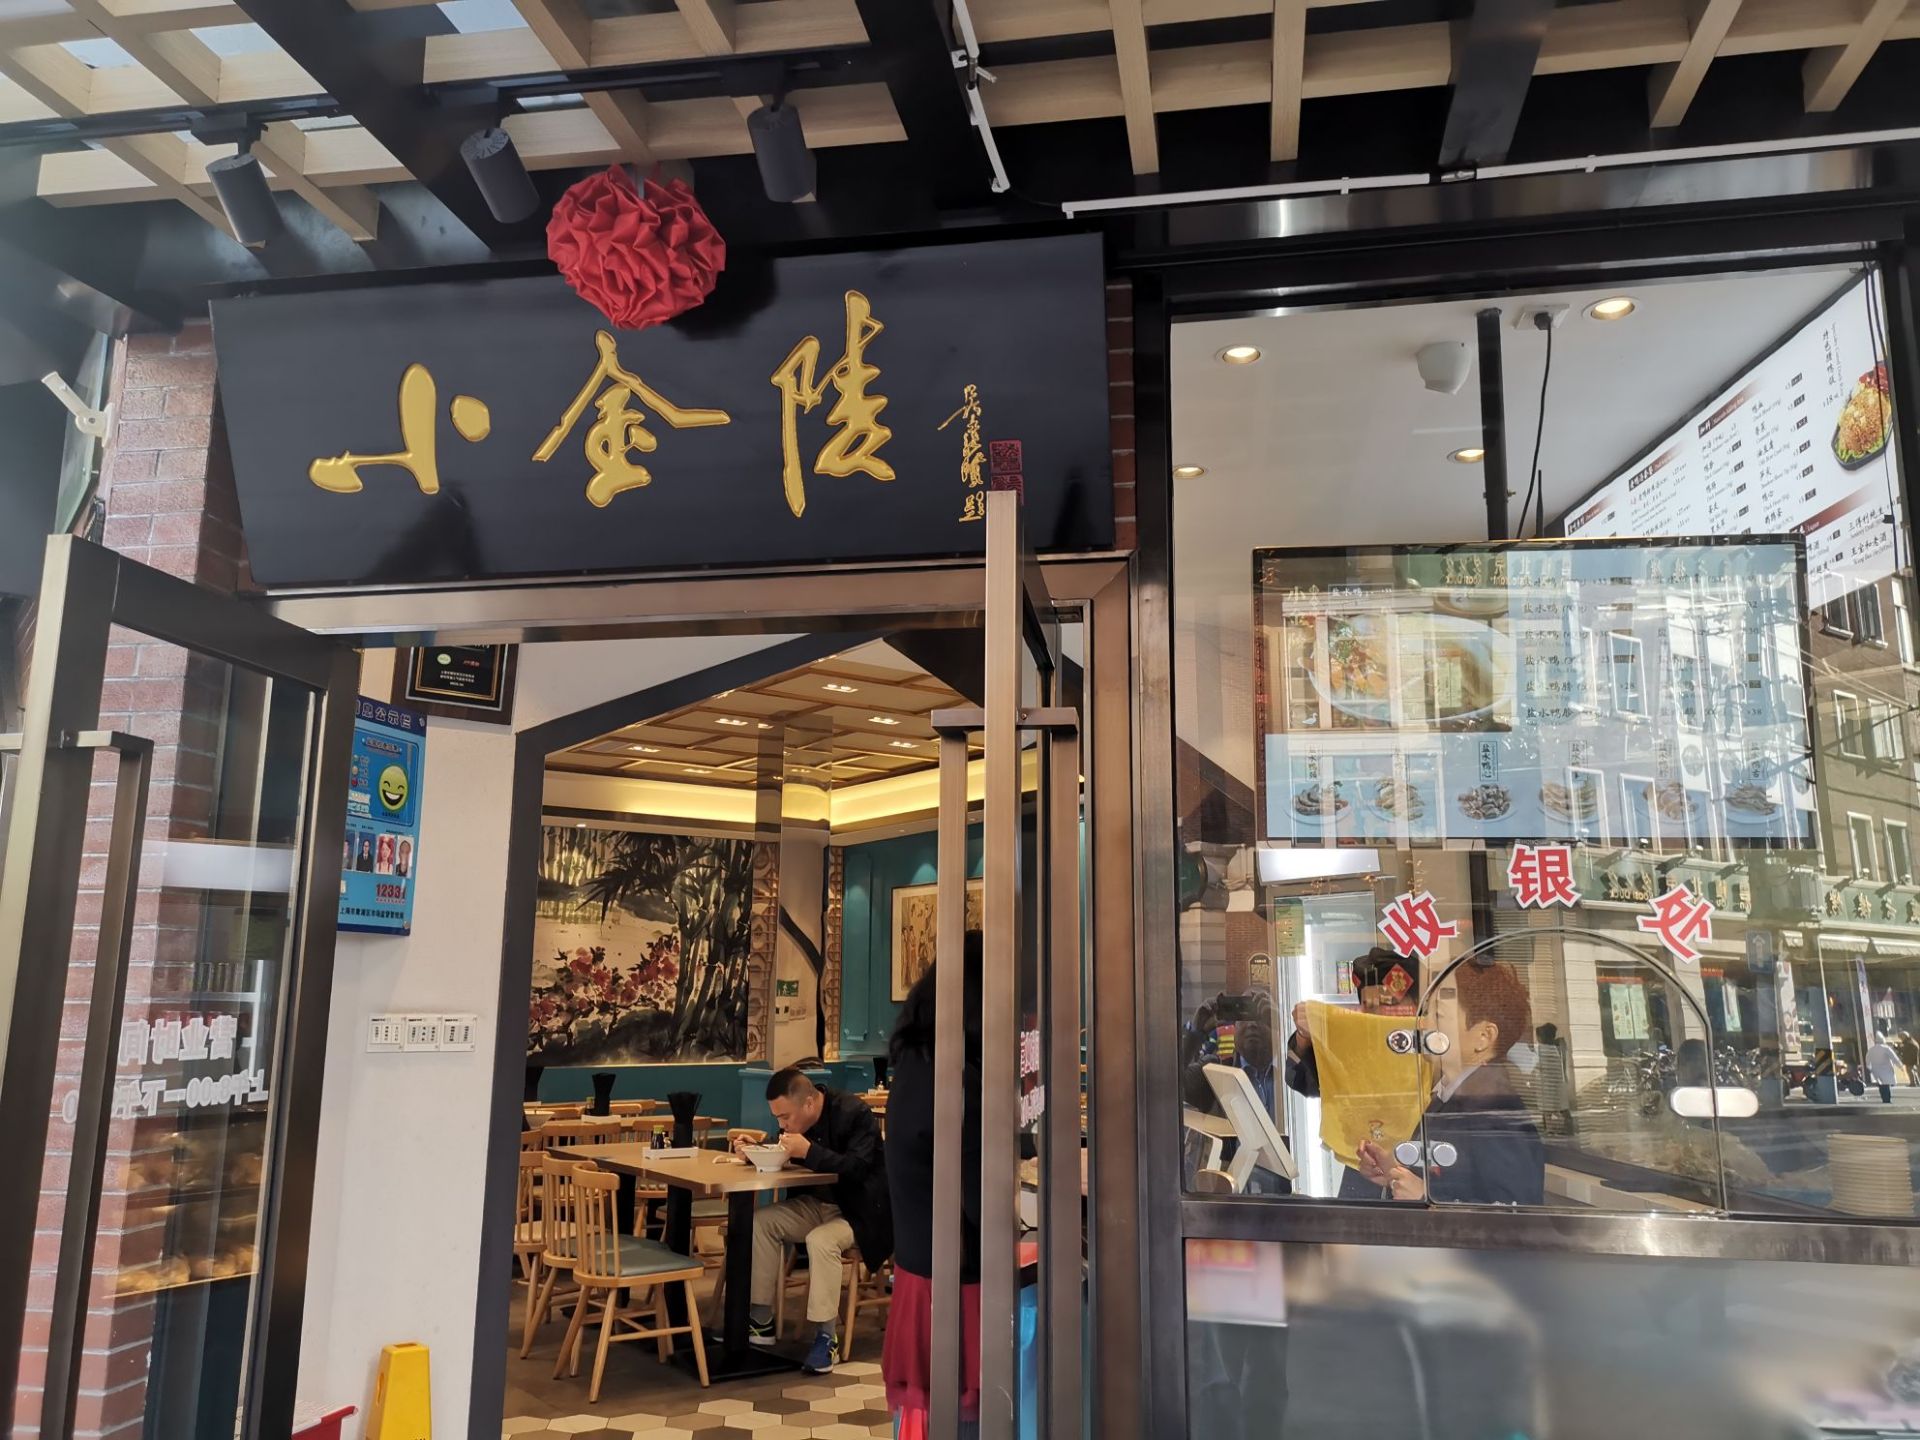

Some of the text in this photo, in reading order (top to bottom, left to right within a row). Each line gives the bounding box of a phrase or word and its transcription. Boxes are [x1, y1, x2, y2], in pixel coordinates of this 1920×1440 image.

[309, 289, 897, 518] 小金陵
[355, 699, 411, 729] 息公示栏
[1379, 844, 1715, 963] 收银处
